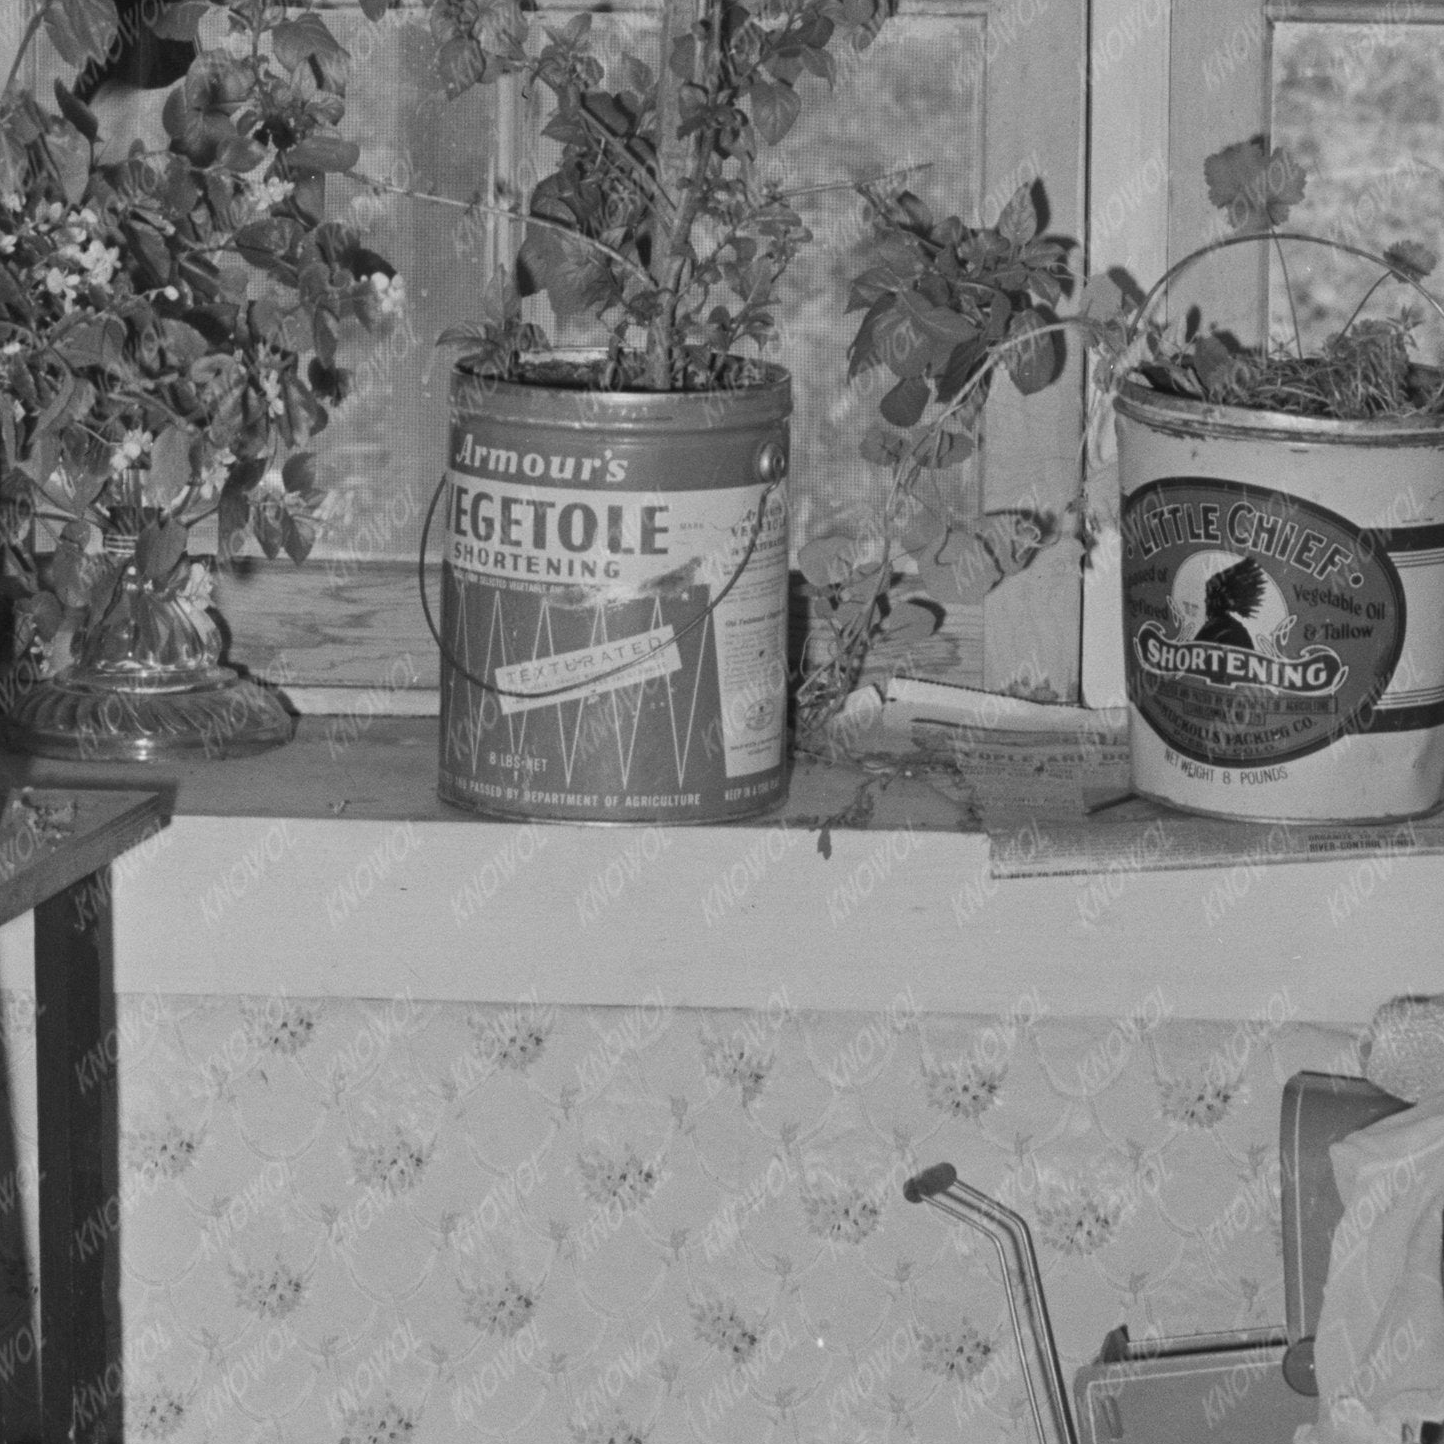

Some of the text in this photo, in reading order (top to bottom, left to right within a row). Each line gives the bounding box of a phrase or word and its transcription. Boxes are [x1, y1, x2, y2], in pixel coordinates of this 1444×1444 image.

[455, 433, 630, 483] Armour's
[453, 540, 622, 580] SHORTENING
[1137, 501, 1354, 581] LITTLE CHIEF
[1292, 583, 1386, 621] Vegetable Oil
[1320, 624, 1376, 641] Tallow
[505, 636, 663, 683] TEXTURATED
[1146, 641, 1328, 688] SHORTENING
[488, 750, 497, 766] 8
[1180, 759, 1215, 783] WEIGHT
[1222, 770, 1232, 785] 8
[1240, 765, 1289, 786] POUNDS
[469, 780, 502, 798] PASSED
[506, 787, 520, 801] BY
[523, 790, 599, 806] DEPARTMENT
[604, 794, 620, 807] OF
[624, 793, 701, 807] AGRICULTURE
